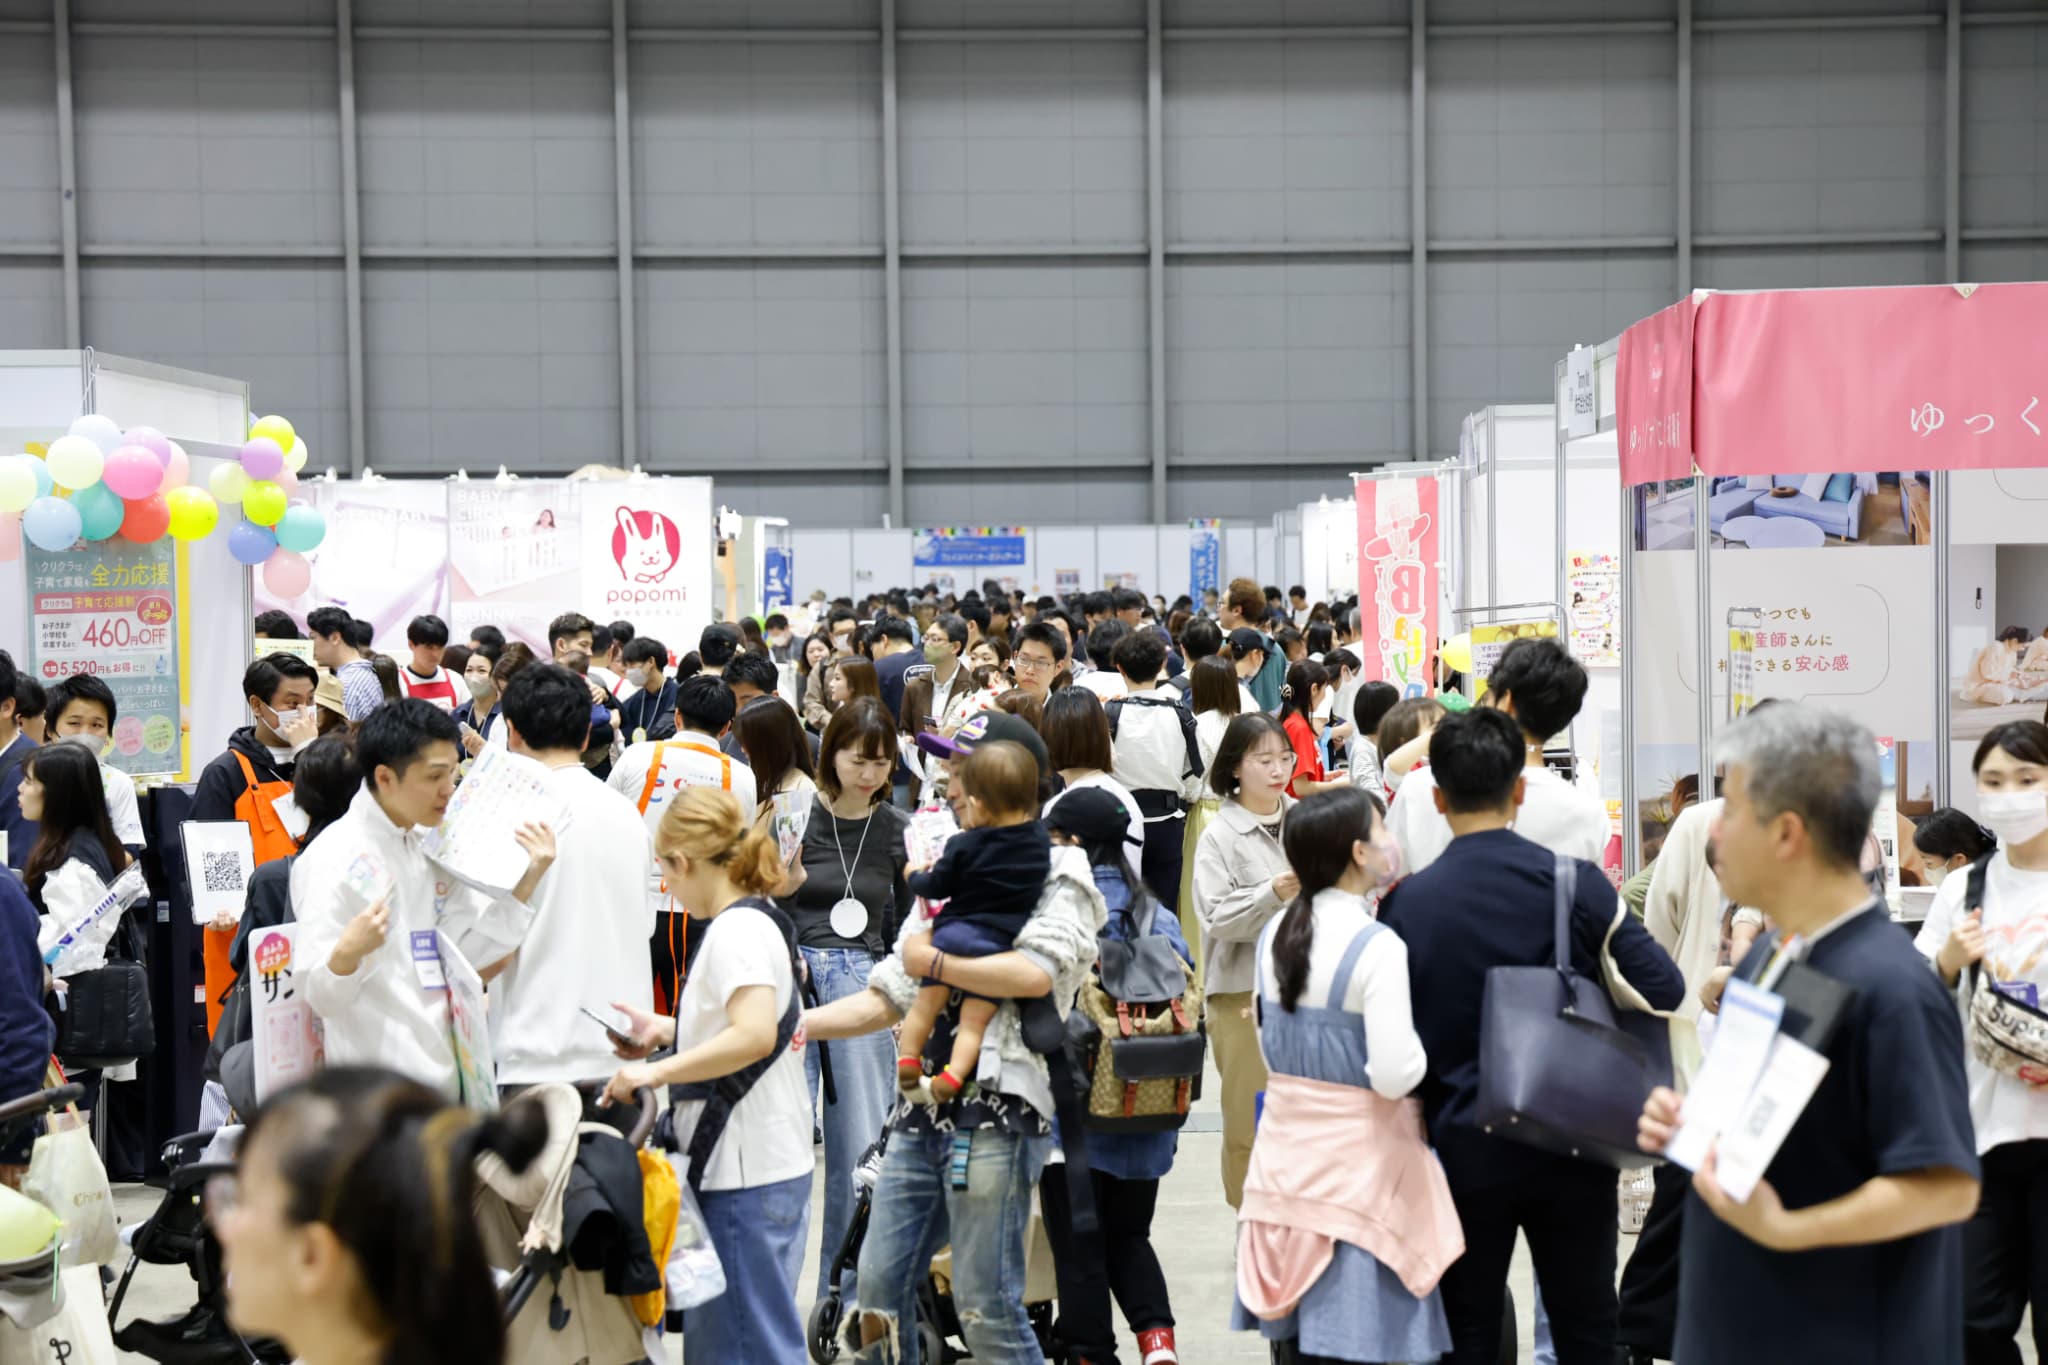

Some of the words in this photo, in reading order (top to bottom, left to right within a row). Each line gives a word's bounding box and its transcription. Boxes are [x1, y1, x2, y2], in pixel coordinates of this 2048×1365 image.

[1911, 396, 2041, 438] ゆっく
[91, 561, 169, 588] 全力応援
[607, 586, 687, 604] popomi
[1754, 607, 1811, 620] いつでも
[1755, 632, 1833, 648] 産師さんに
[1718, 654, 1849, 672] 相できる安心感
